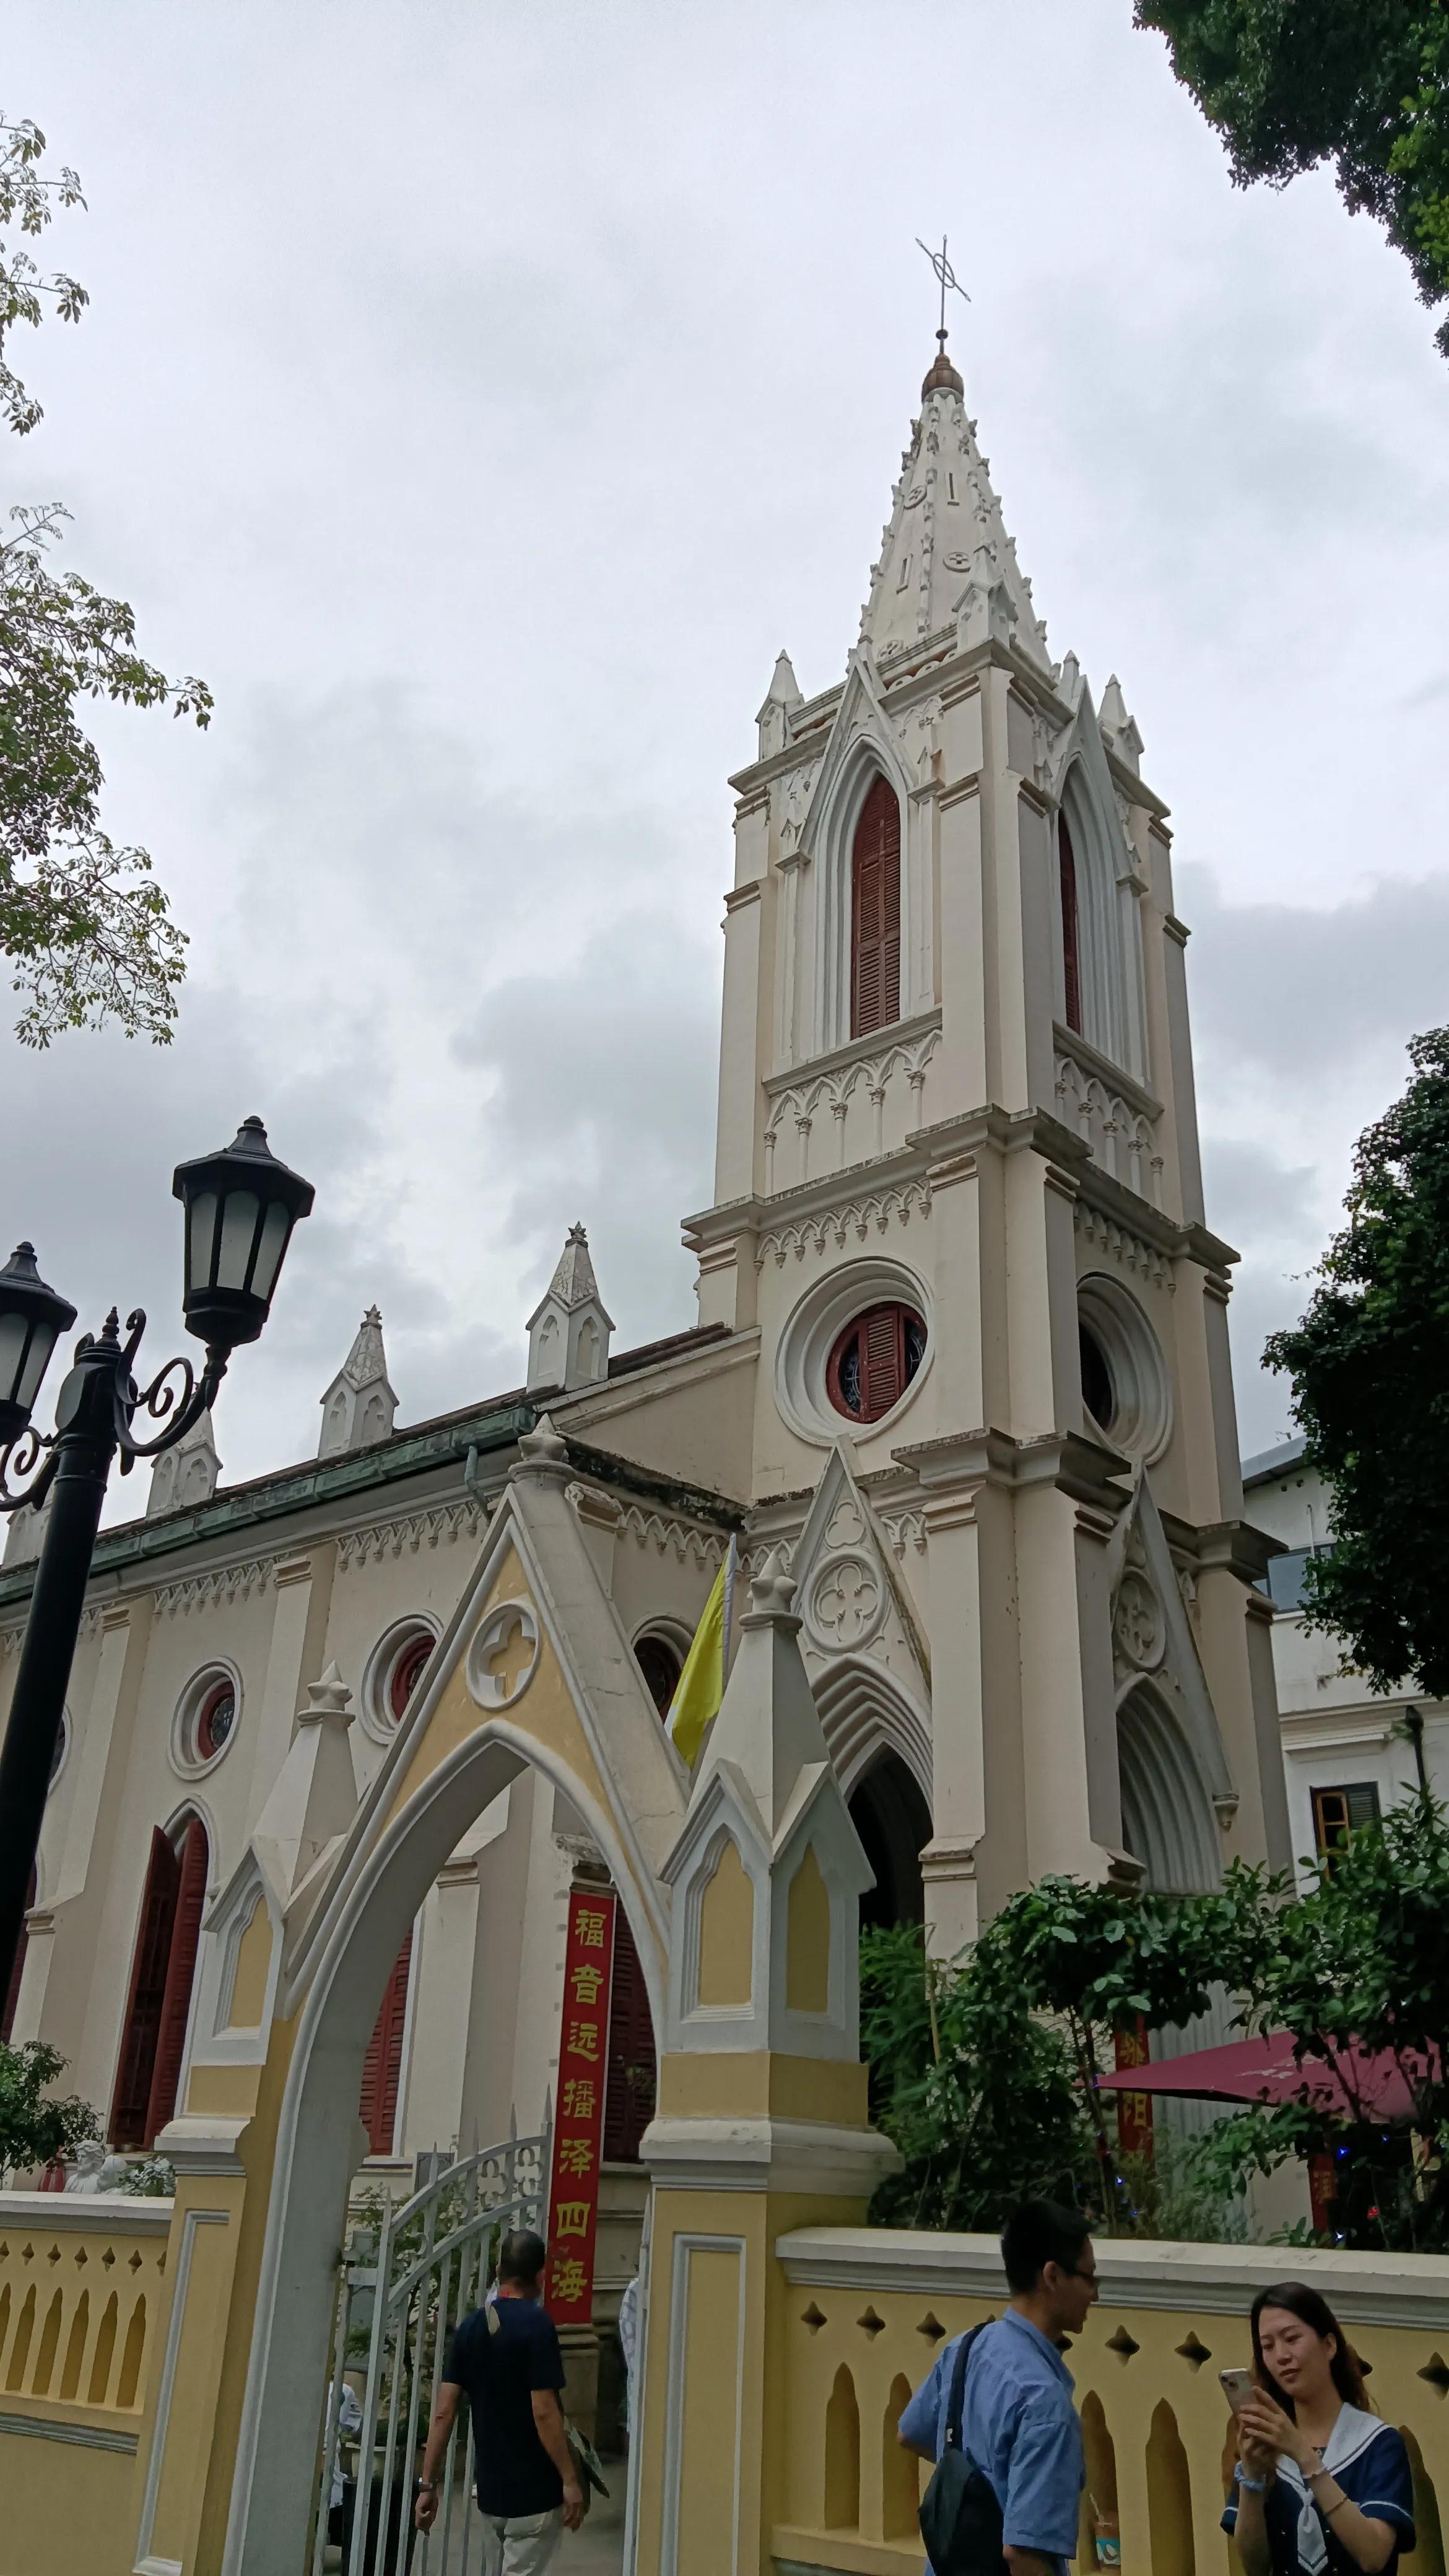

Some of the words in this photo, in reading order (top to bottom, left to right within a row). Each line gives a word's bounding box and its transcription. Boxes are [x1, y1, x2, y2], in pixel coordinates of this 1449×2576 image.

[551, 1909, 606, 2302] 福音远播泽四海
